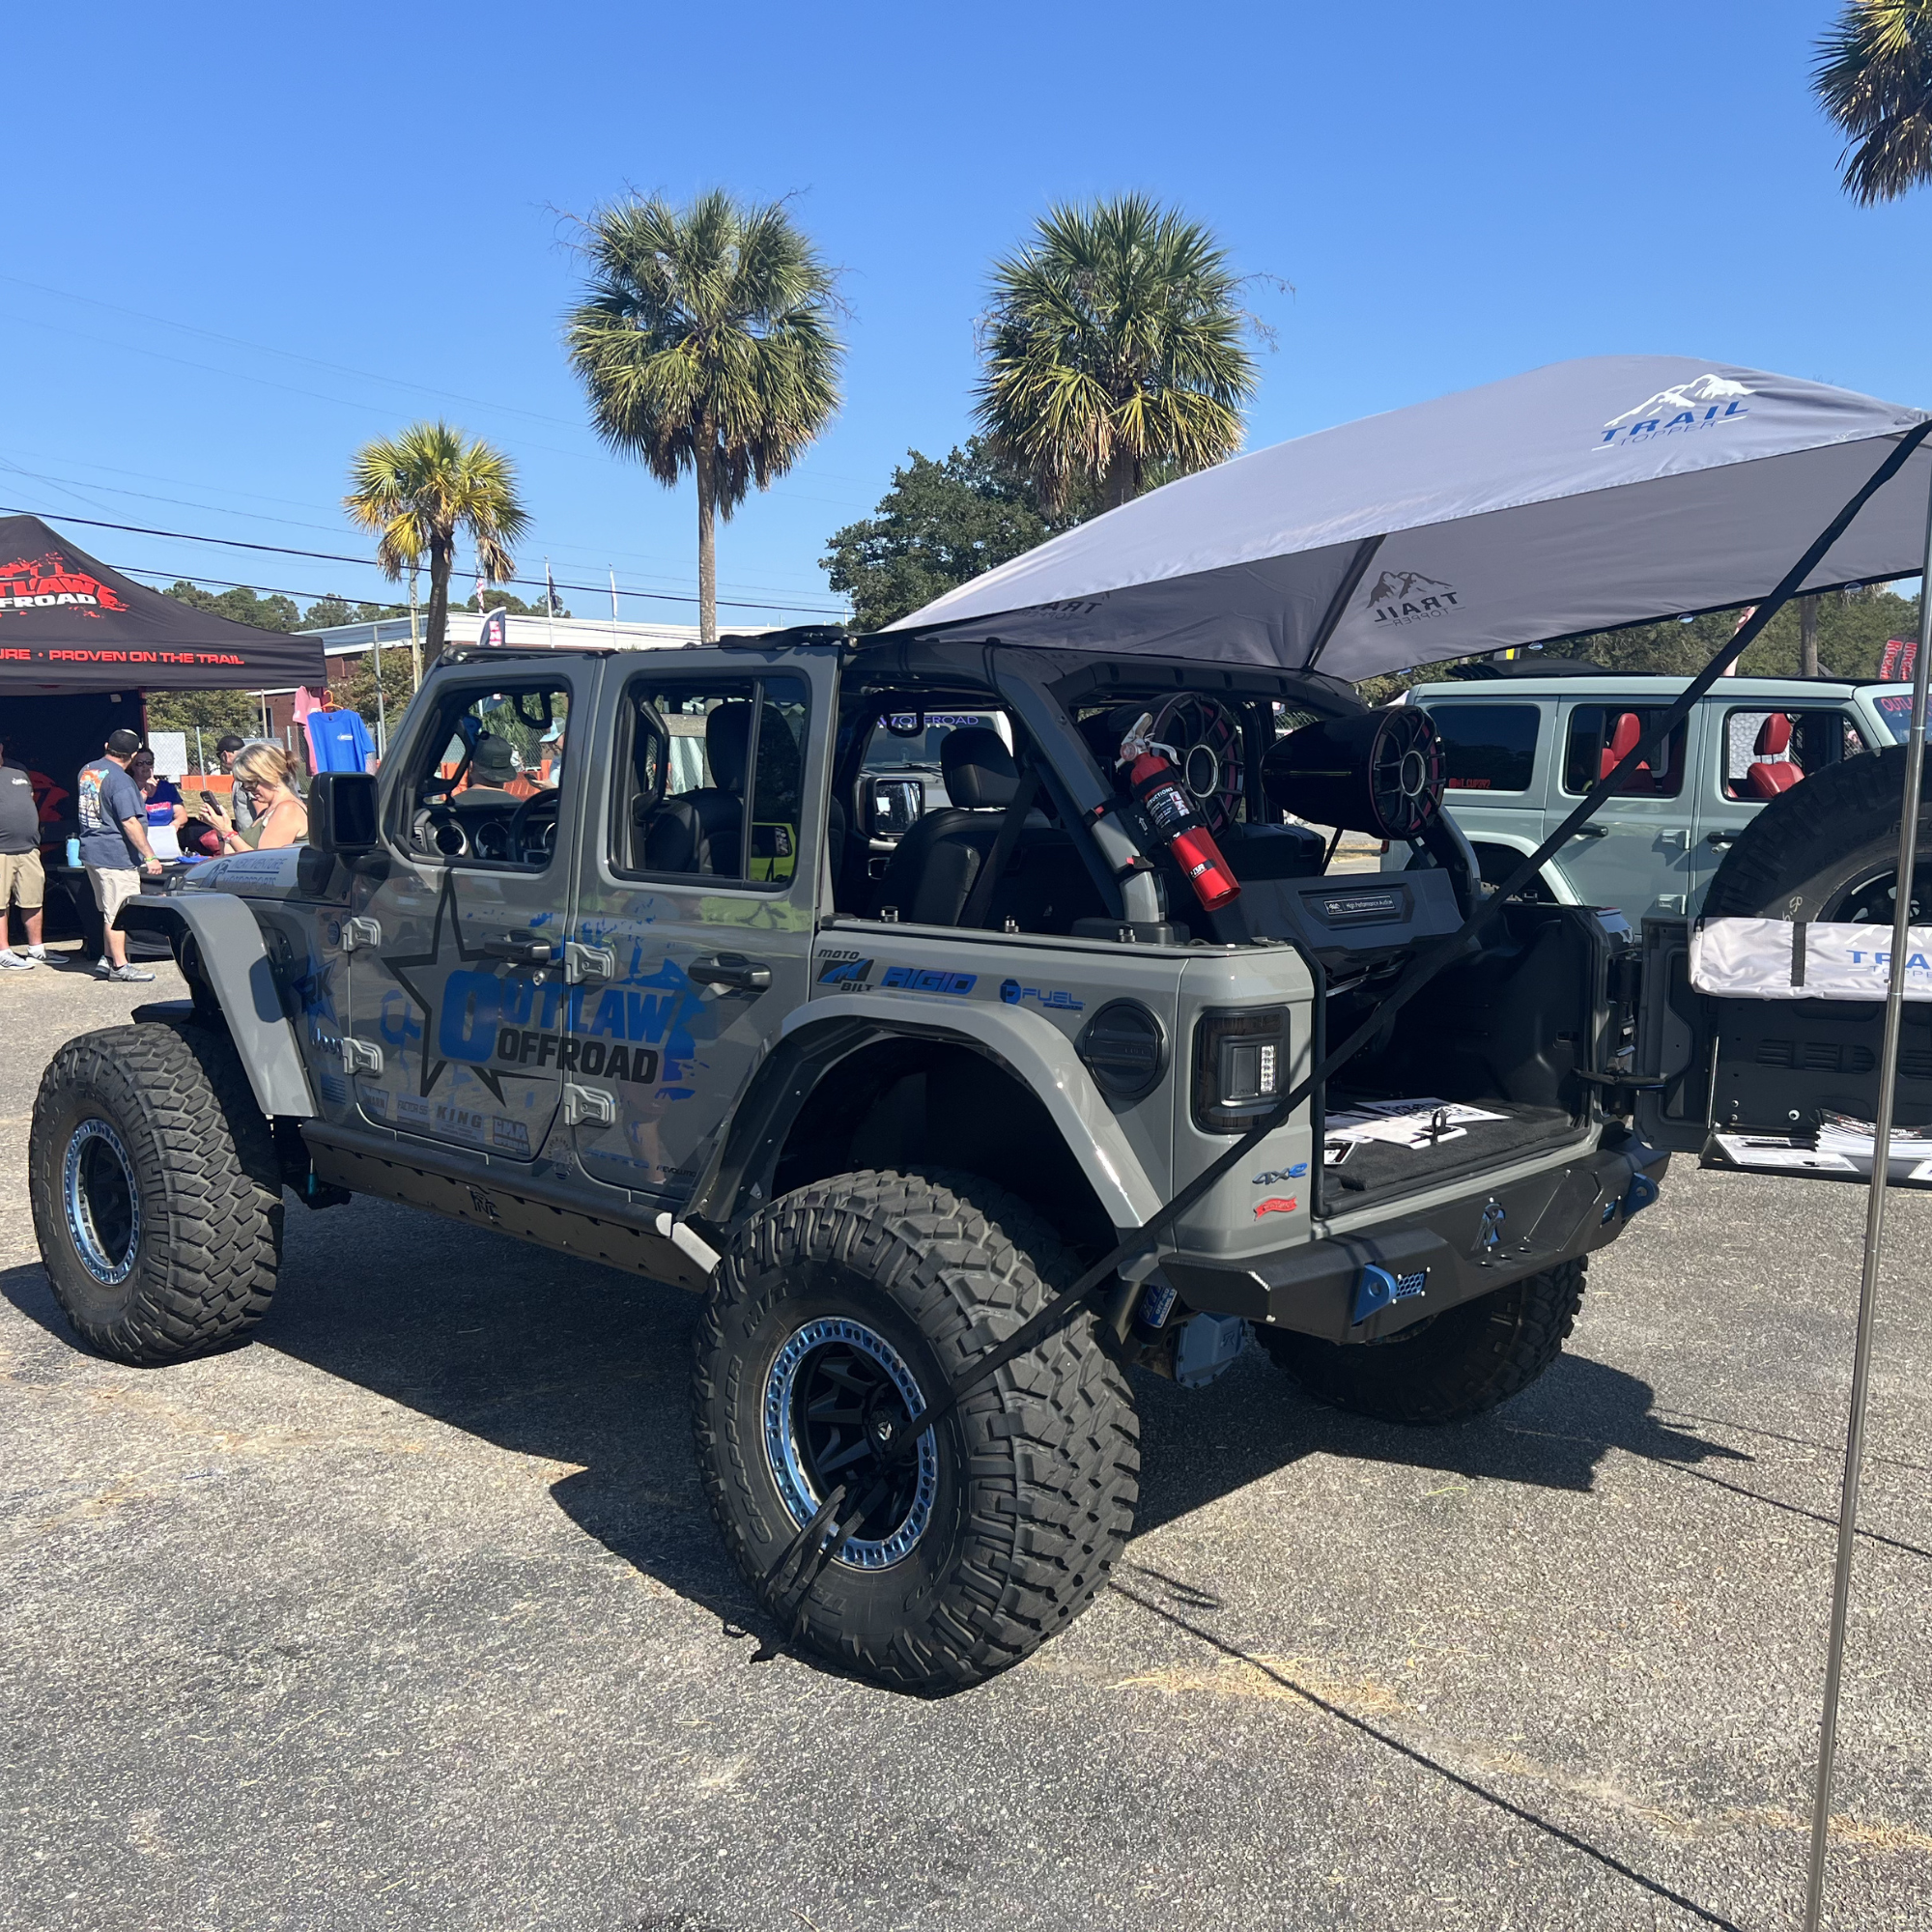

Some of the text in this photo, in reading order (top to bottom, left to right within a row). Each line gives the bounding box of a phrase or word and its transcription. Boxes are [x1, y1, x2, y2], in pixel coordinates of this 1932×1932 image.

[1601, 401, 1749, 442] TRAIL
[1620, 420, 1718, 446] TOPPER
[48, 649, 127, 662] PROVEN
[129, 651, 156, 663] ON
[159, 652, 194, 664] THE
[196, 653, 244, 665] TRAIL
[818, 949, 860, 960] MOTO
[840, 981, 874, 992] BILT
[880, 966, 978, 995] RIGID
[1022, 987, 1083, 1006] FUEL
[439, 970, 673, 1063] OUTLAW
[497, 1027, 659, 1084] OFFROAD
[437, 1105, 482, 1129] KING
[716, 1353, 773, 1544] GRAPPLER
